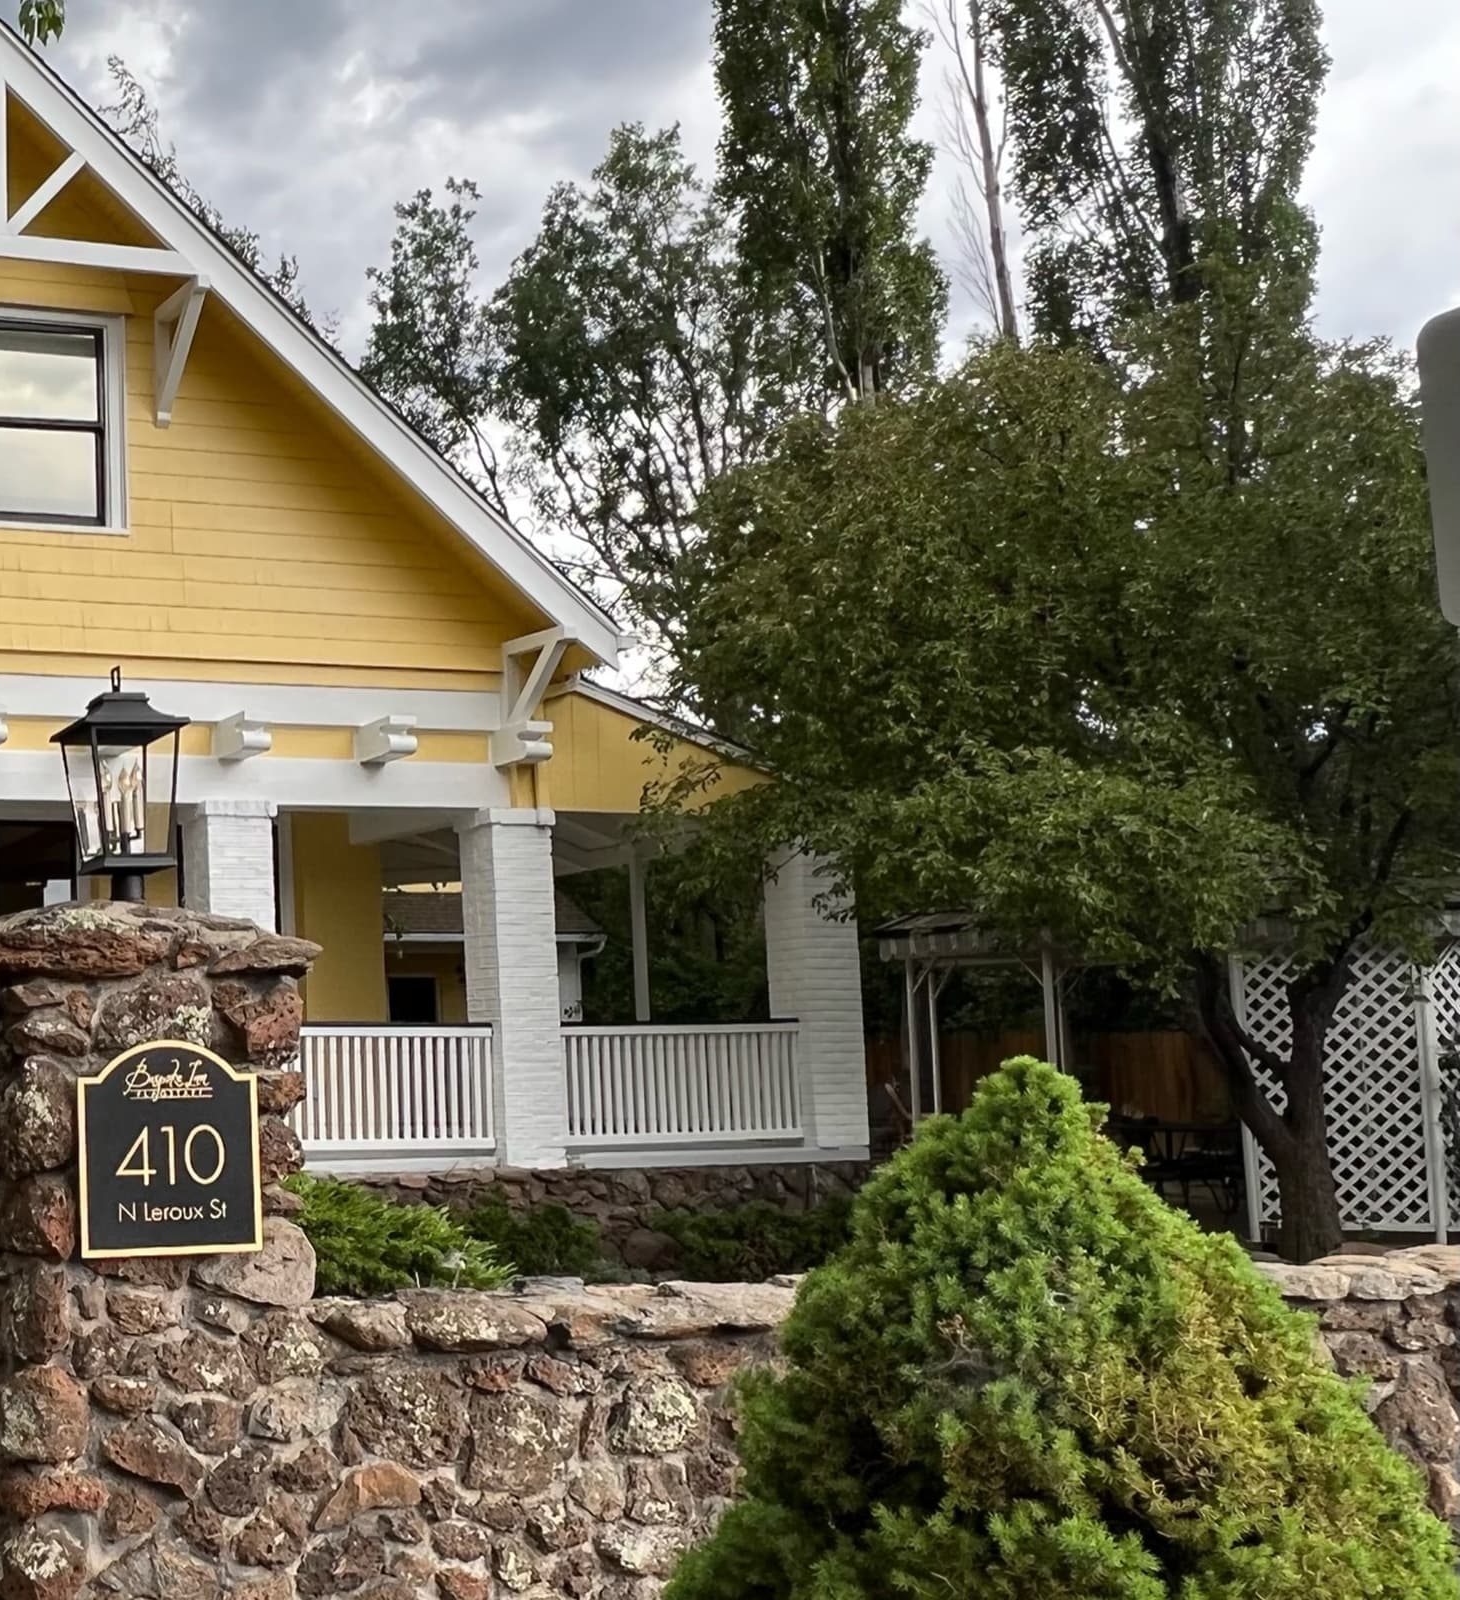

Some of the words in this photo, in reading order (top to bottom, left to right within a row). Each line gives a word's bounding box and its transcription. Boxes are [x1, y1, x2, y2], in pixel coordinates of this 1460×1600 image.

[123, 1058, 183, 1102] Bespoke
[184, 1060, 210, 1088] Inn
[116, 1124, 225, 1186] 410
[118, 1202, 136, 1222] N
[144, 1202, 203, 1222] Leroux
[209, 1198, 227, 1219] St
